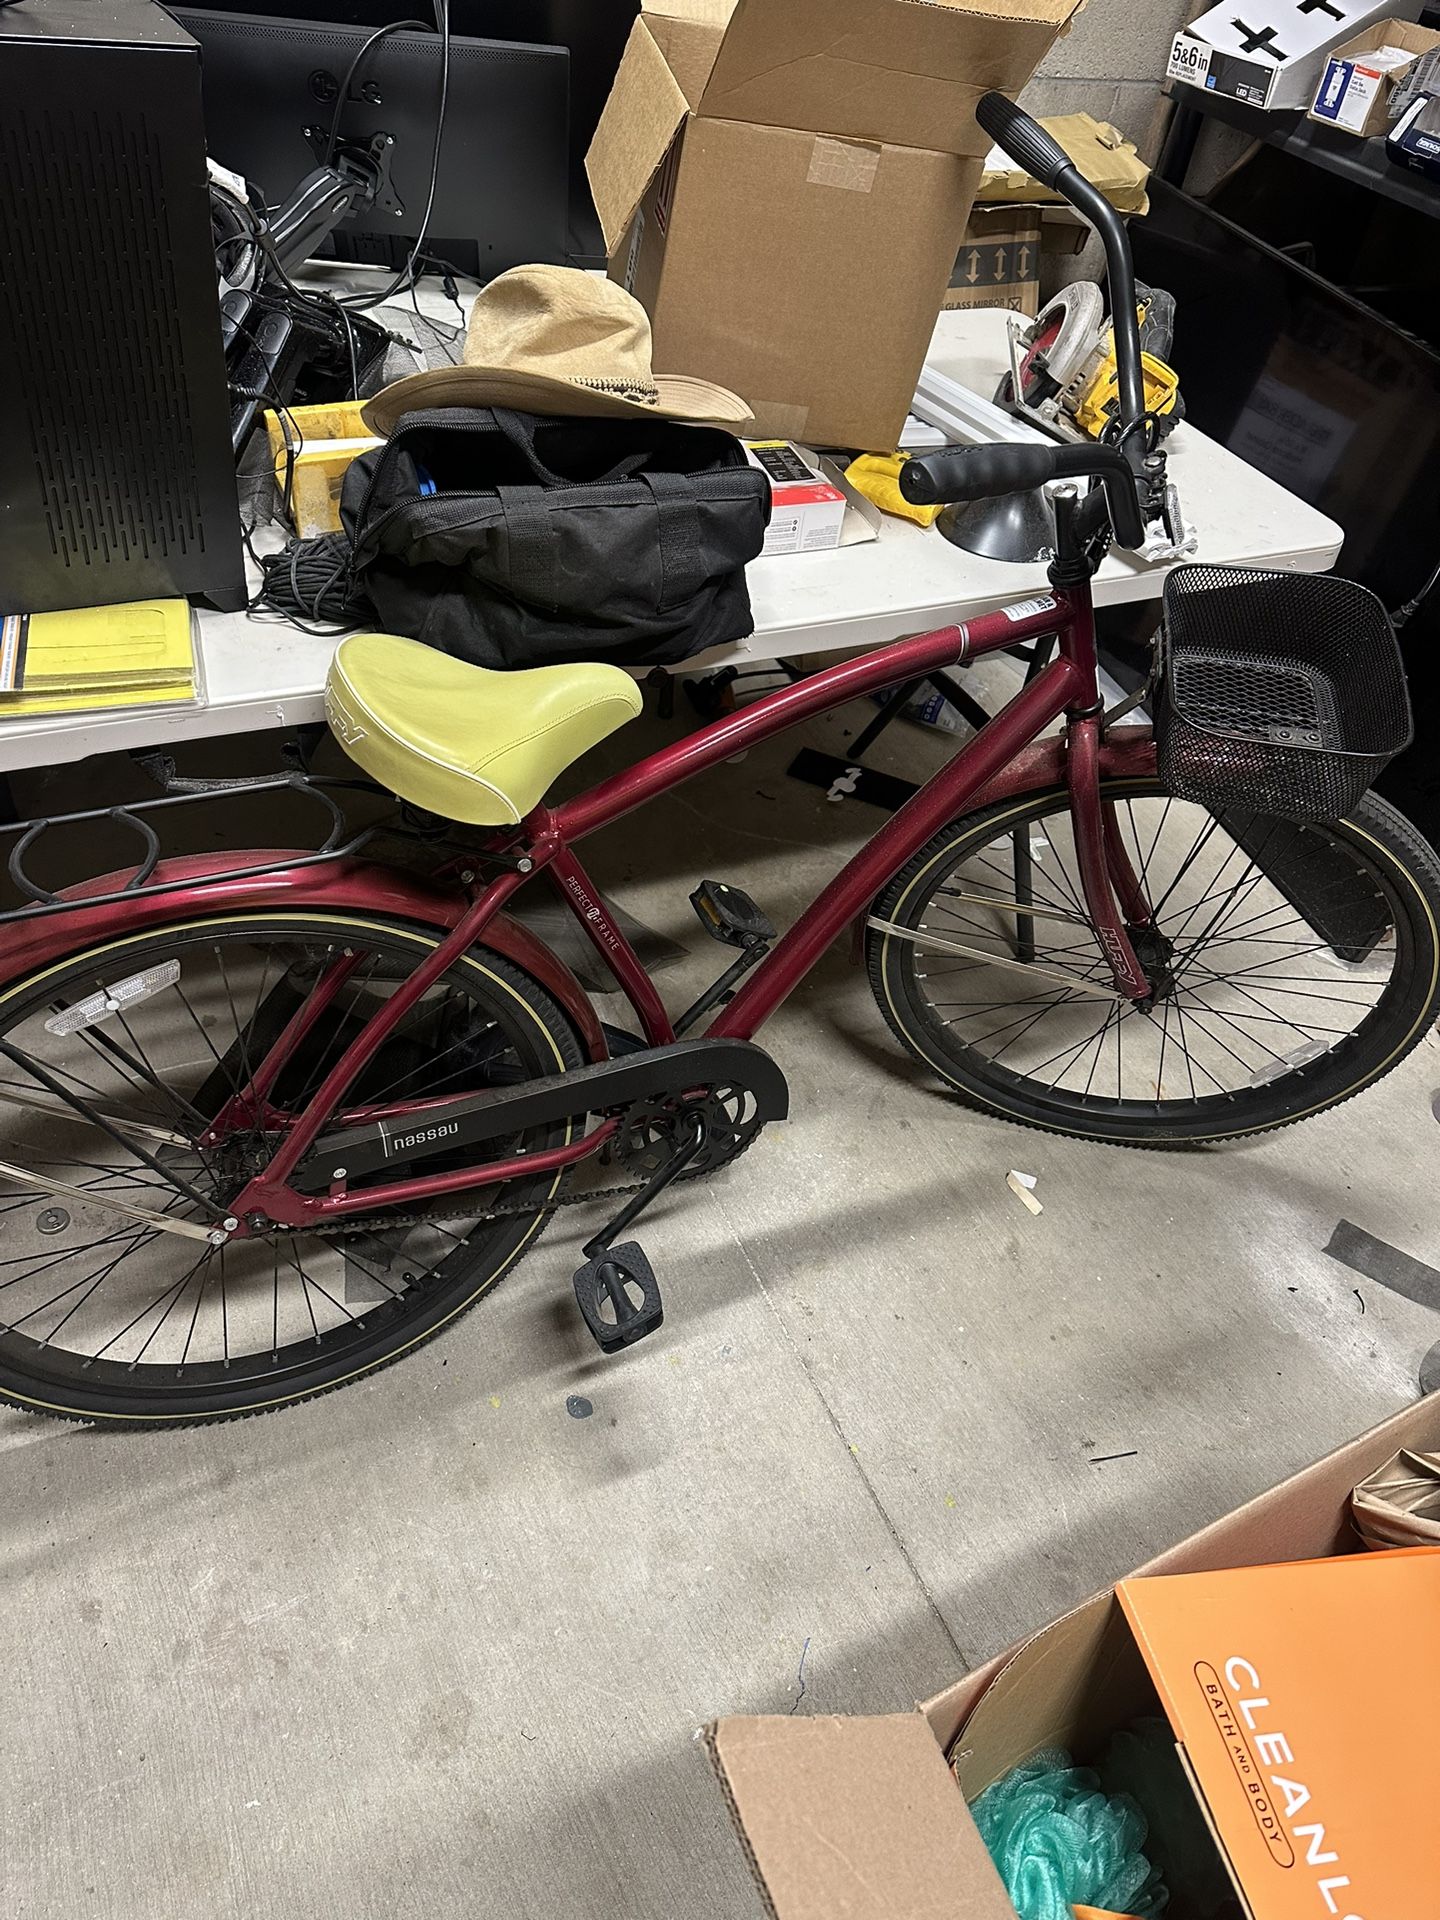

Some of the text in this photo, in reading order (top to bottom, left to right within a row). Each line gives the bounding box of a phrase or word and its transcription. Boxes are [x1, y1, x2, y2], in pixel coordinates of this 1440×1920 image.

[346, 79, 384, 105] LG
[1235, 87, 1247, 97] LED
[945, 301, 971, 310] GLASS
[973, 298, 1005, 309] MIRROR
[566, 875, 594, 912] PERFECT
[594, 918, 620, 951] FRAME
[1099, 926, 1138, 985] HUFFY
[393, 1122, 459, 1150] nassau
[1206, 1684, 1282, 1843] BATH AND BODY
[1225, 1656, 1366, 1920] CLEANL
